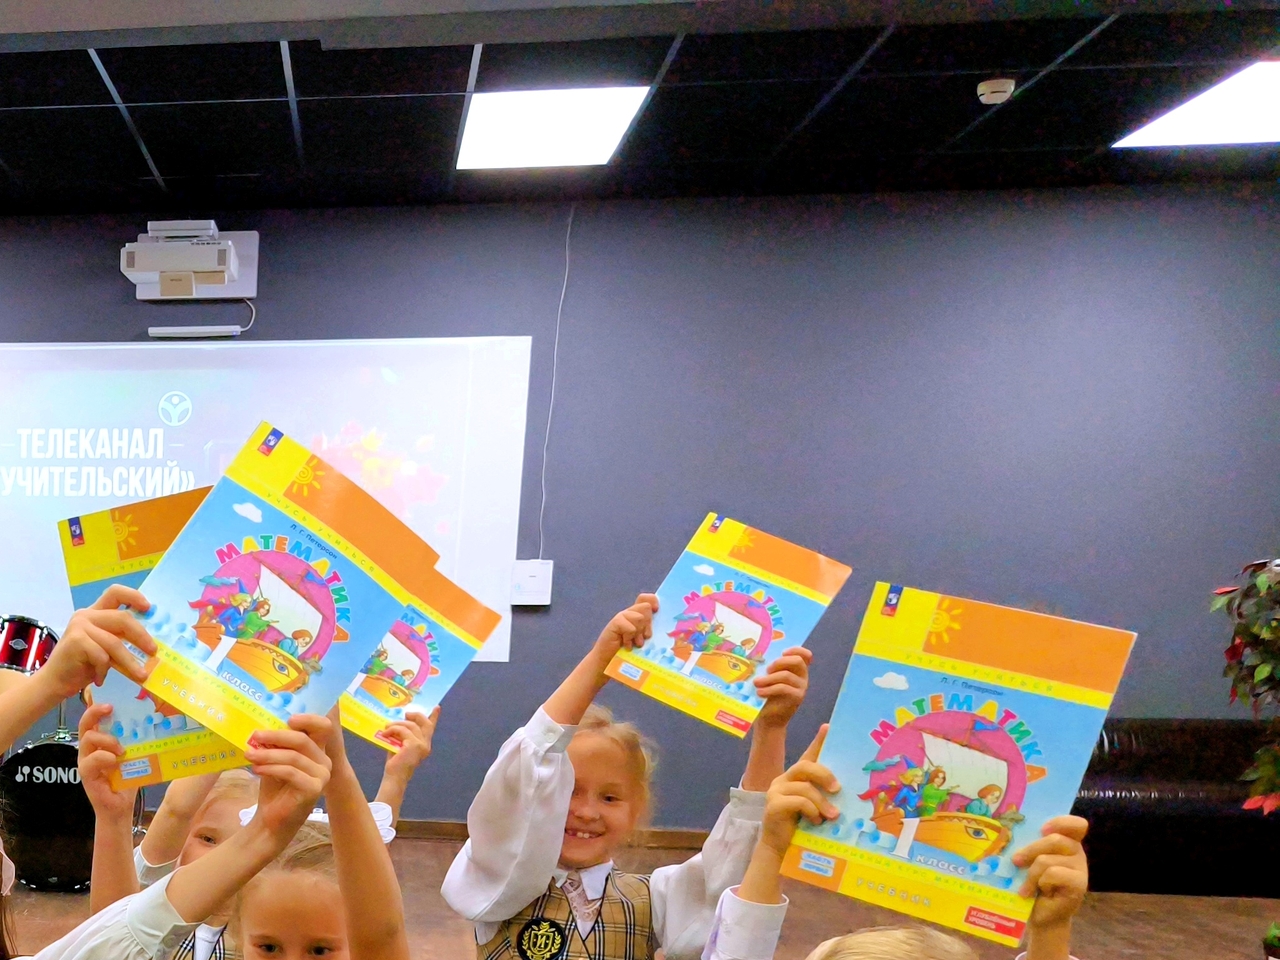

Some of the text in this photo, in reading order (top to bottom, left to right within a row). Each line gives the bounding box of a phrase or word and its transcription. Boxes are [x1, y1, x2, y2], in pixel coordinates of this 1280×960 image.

[17, 428, 164, 459] ТЕЛЕКАНАЛ
[215, 534, 351, 643] МАТЕМАТИКА
[683, 581, 785, 641] МАТЕМАТИКА
[203, 634, 264, 702] 1 класс
[162, 678, 226, 722] УЧЕБНИК
[172, 749, 237, 769] УЧЕБНИК
[870, 693, 1048, 784] МАТЕМАТИКА
[891, 817, 966, 876] 1 класс
[855, 877, 932, 907] УЧЕБНИК
